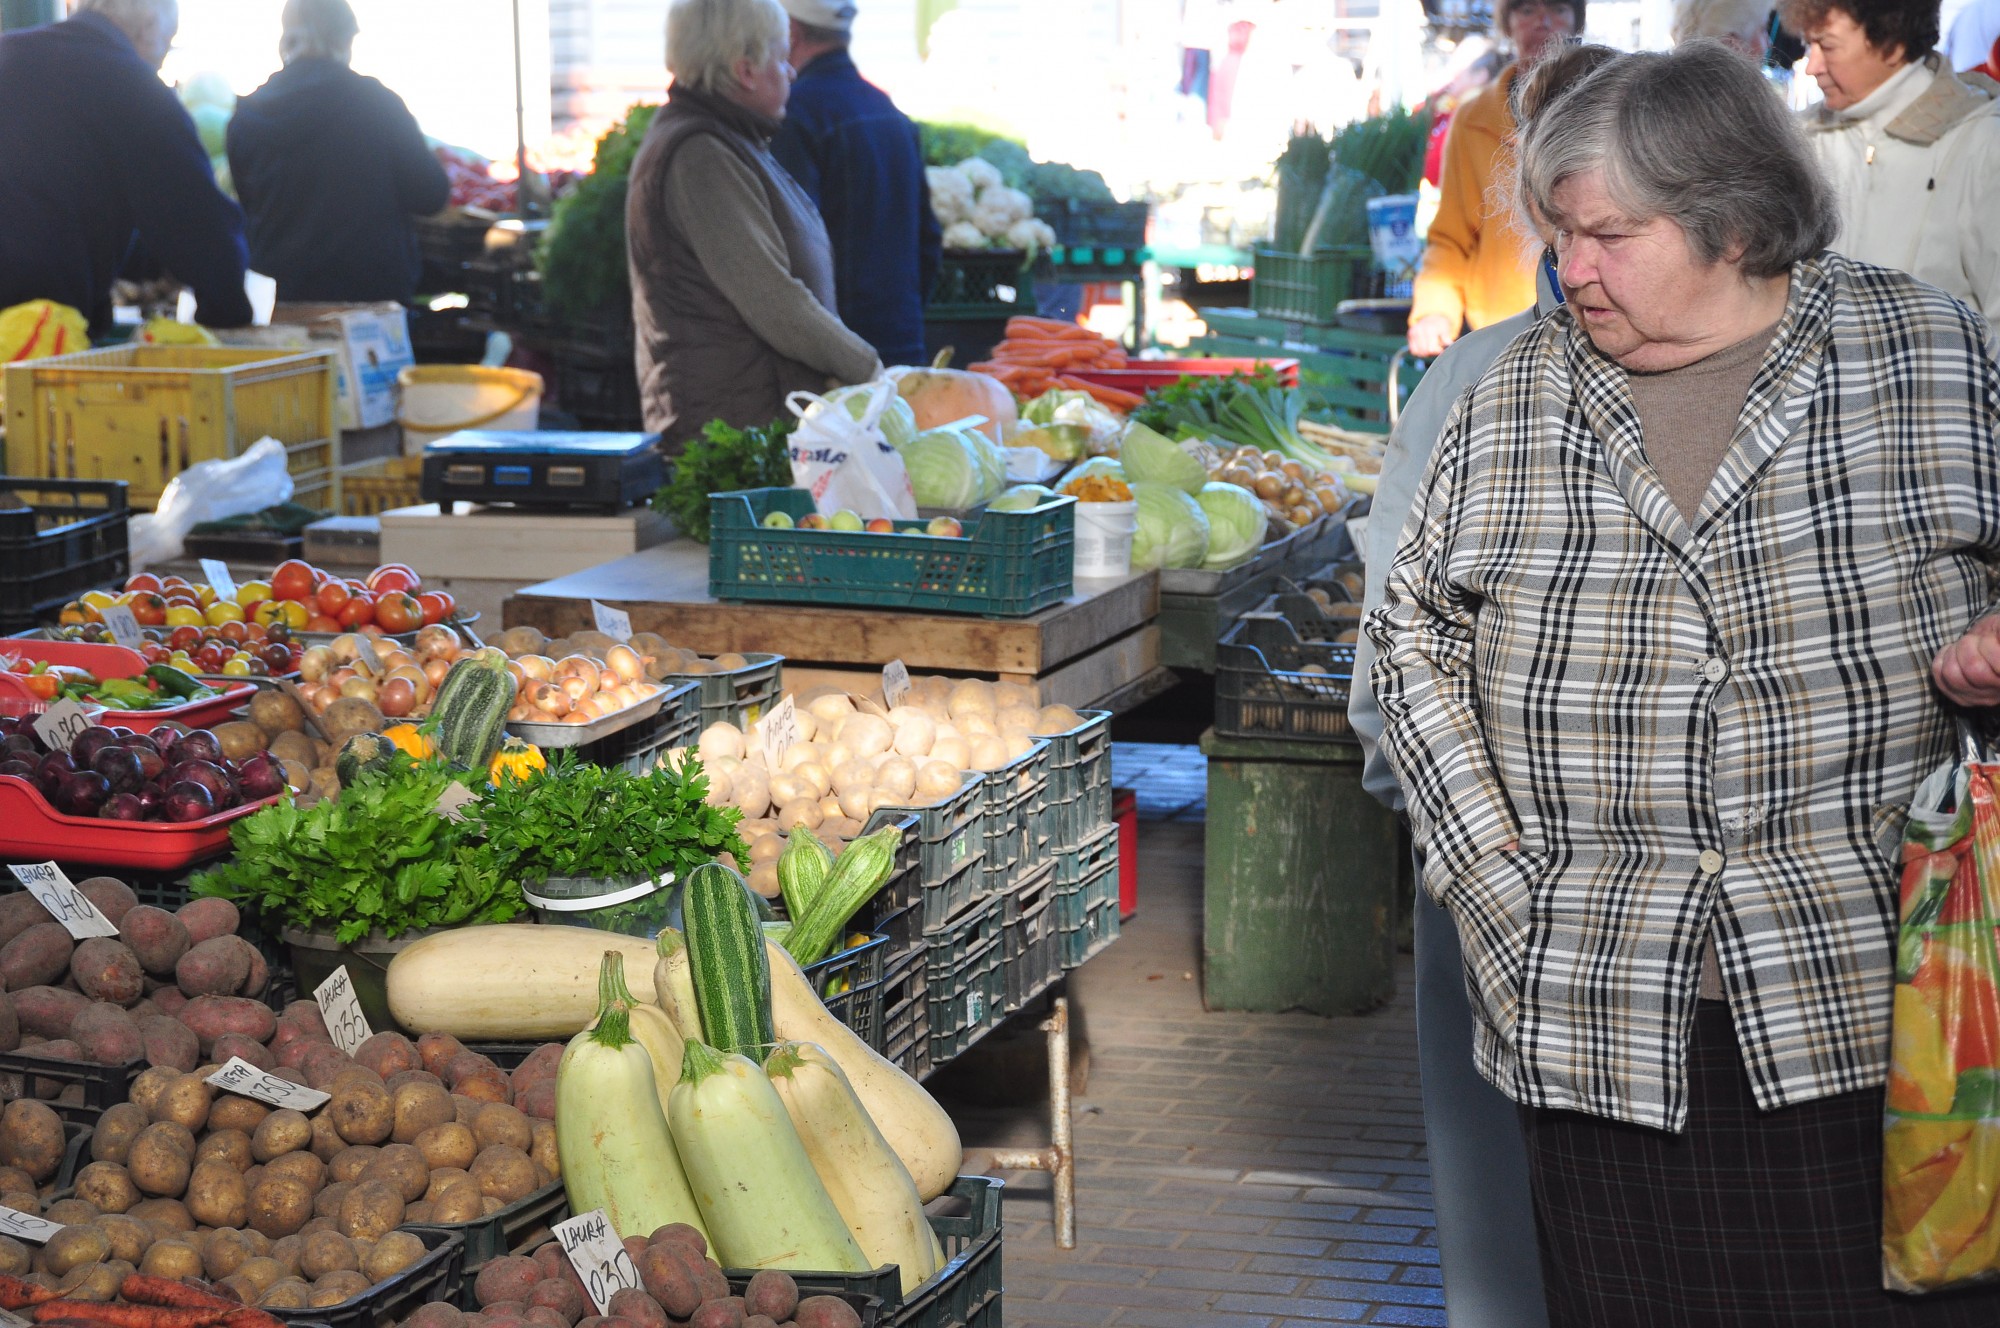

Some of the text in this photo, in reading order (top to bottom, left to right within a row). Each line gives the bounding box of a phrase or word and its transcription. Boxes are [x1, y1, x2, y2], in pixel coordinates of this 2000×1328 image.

[15, 865, 56, 884] LAURA
[320, 974, 348, 1015] LAURA
[562, 1215, 608, 1253] LAURA
